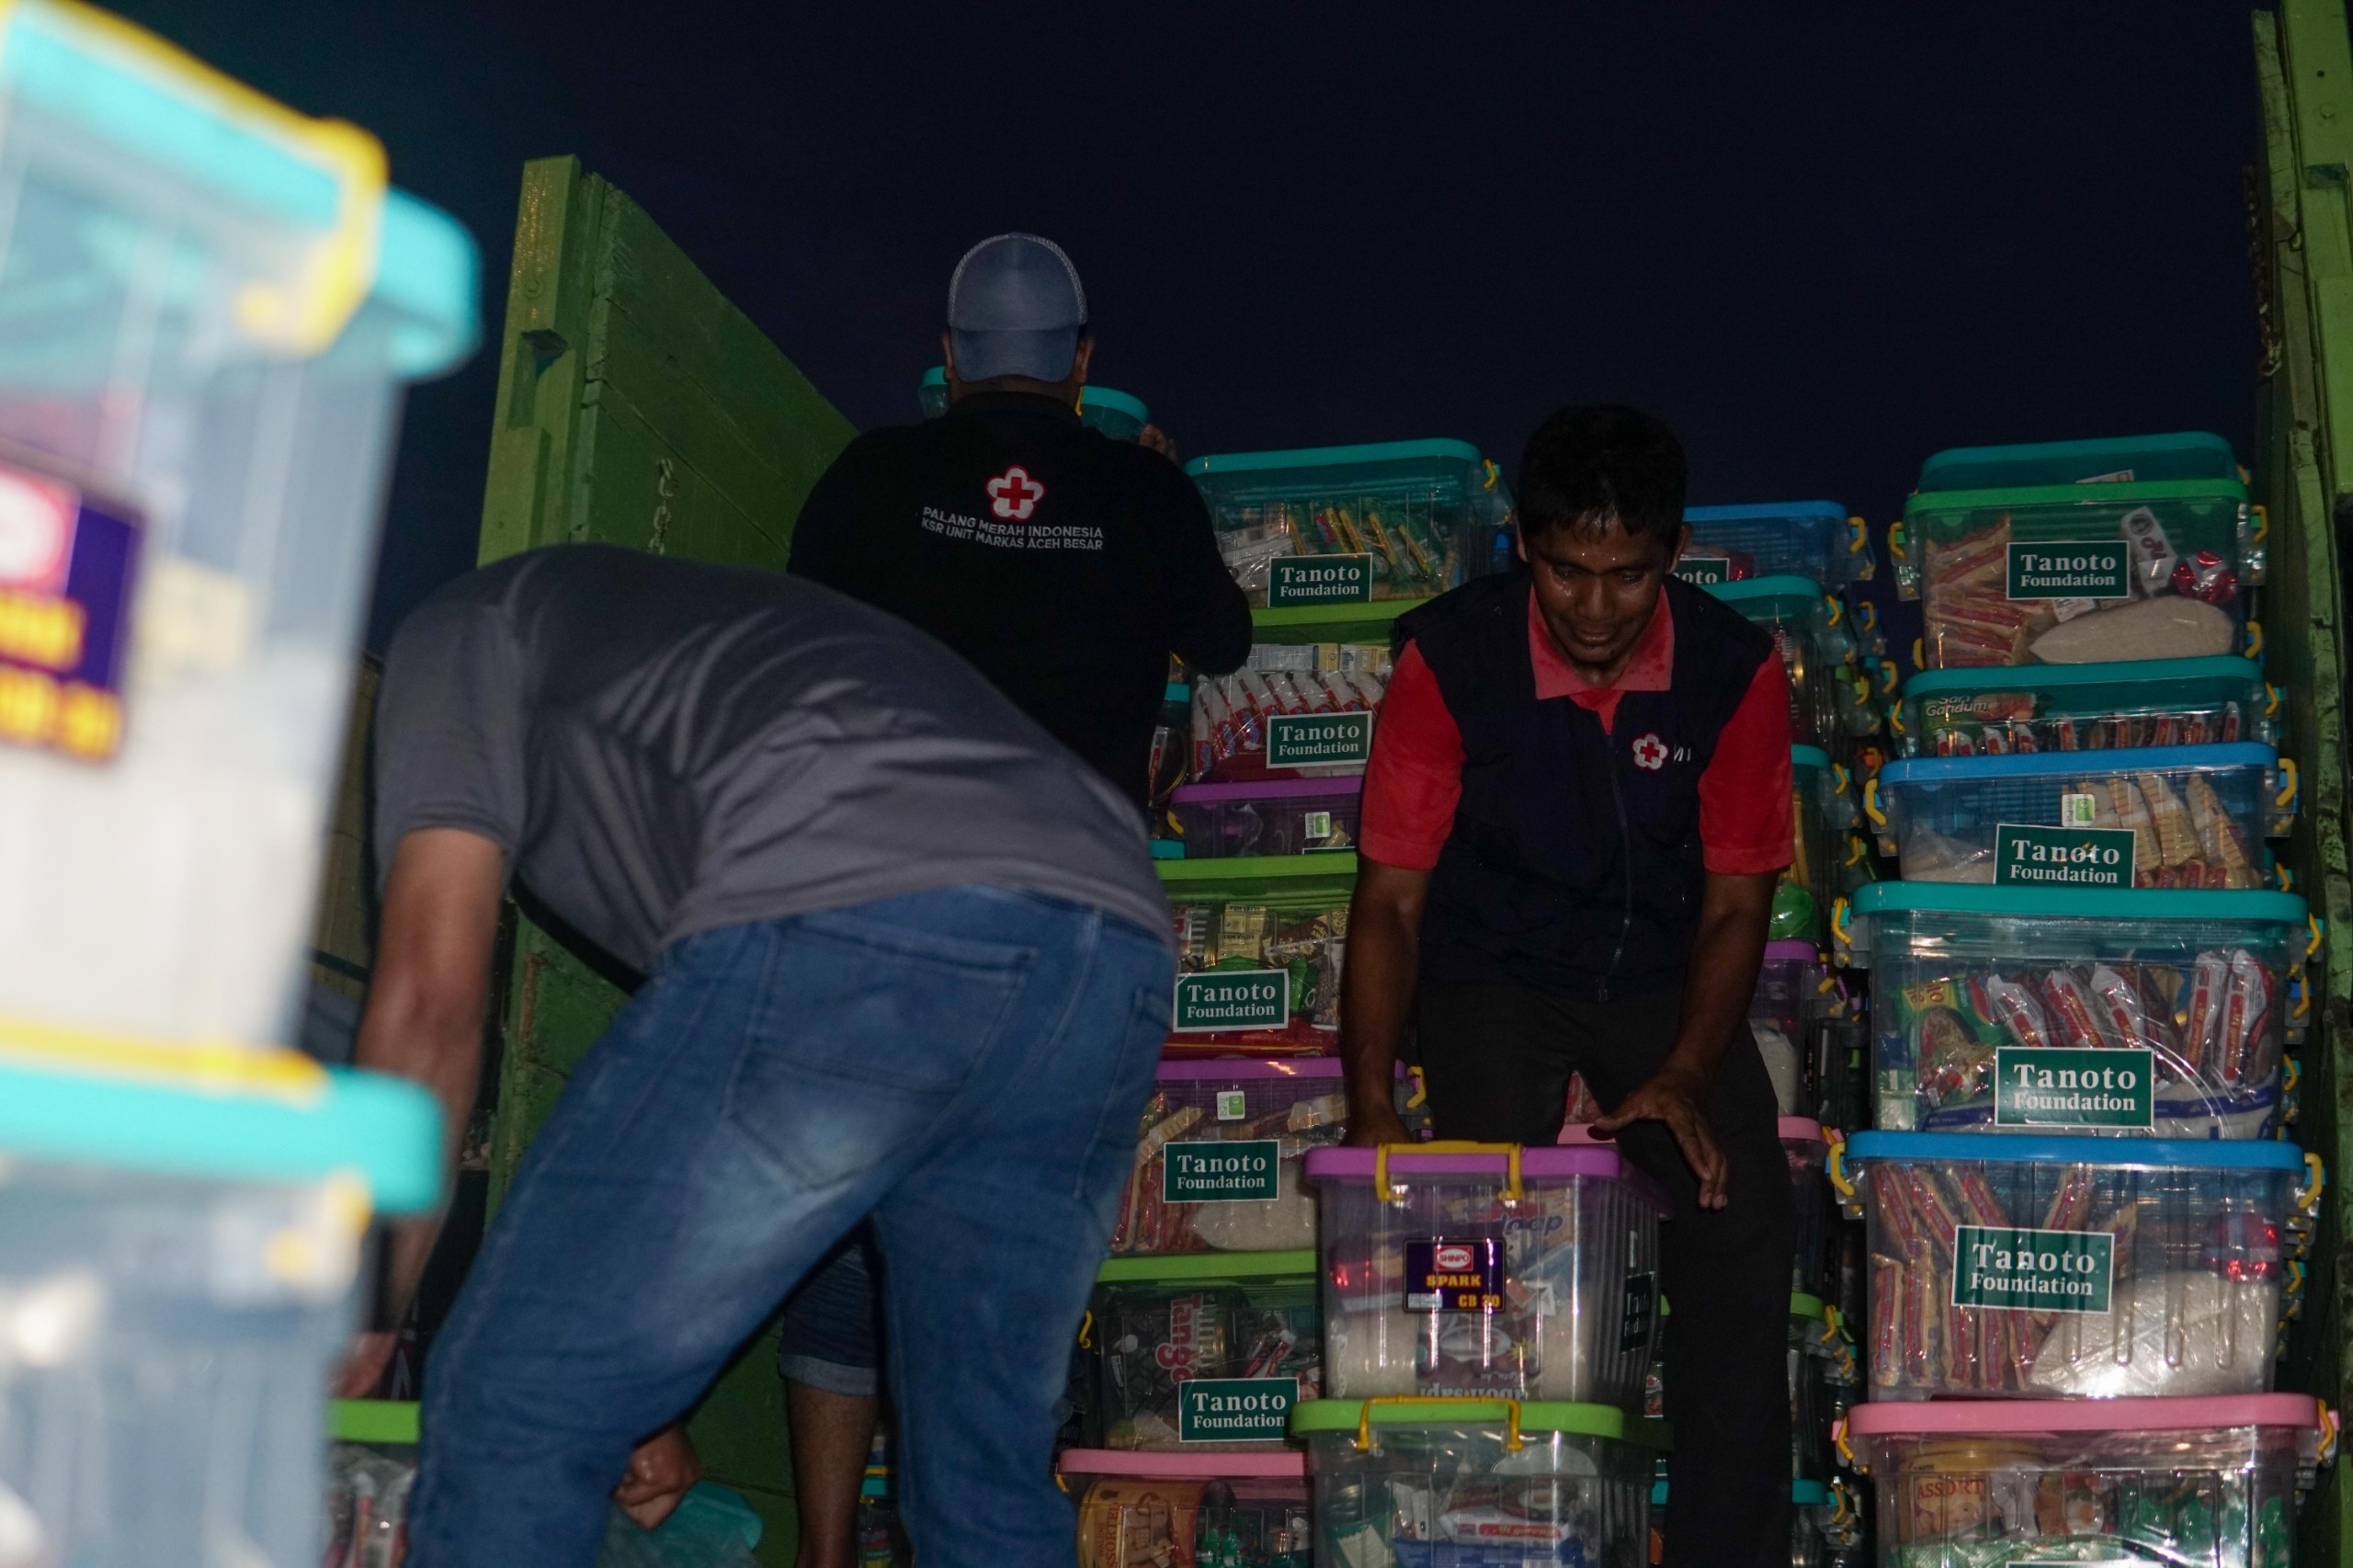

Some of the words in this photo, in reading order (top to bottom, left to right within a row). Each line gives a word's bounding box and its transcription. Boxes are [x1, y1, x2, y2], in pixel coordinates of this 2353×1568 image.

[923, 506, 976, 528] PALANG
[979, 519, 1025, 536] MERAH
[1029, 526, 1103, 539] INDONESIA
[922, 518, 944, 534] KSR
[947, 526, 973, 540] UNIT
[975, 530, 1025, 548] MARKAS
[1027, 538, 1061, 550] ACEH
[1063, 538, 1103, 551] BESAR
[2020, 553, 2117, 572] Tanoto
[1279, 565, 1360, 584] Tanoto
[1672, 570, 1718, 585] oto
[2020, 573, 2116, 587] Foundation
[1279, 583, 1359, 597] Foundation
[1926, 701, 1988, 717] Gandum
[1279, 723, 1360, 742] Tanoto
[1278, 741, 1359, 756] Foundation
[2010, 838, 2120, 865] Tanoto
[2009, 864, 2119, 883] Foundation
[1187, 983, 1276, 1003] Tanoto
[1187, 1003, 1276, 1018] Foundation
[2013, 1063, 2137, 1090] Tanoto
[2013, 1092, 2136, 1112] Foundation
[1176, 1154, 1267, 1173] Tanoto
[1176, 1175, 1266, 1190] Foundation
[1438, 1254, 1470, 1263] SHINPO
[1972, 1243, 2096, 1274] Tanoto
[1426, 1274, 1483, 1288] SPARK
[1971, 1272, 2094, 1296] Foundation
[1458, 1294, 1478, 1308] CB
[1192, 1392, 1287, 1413] Tanoto
[1193, 1413, 1286, 1429] Foundation
[1917, 1480, 1984, 1500] ASSORT
[1105, 1502, 1120, 1568] SSORTED
